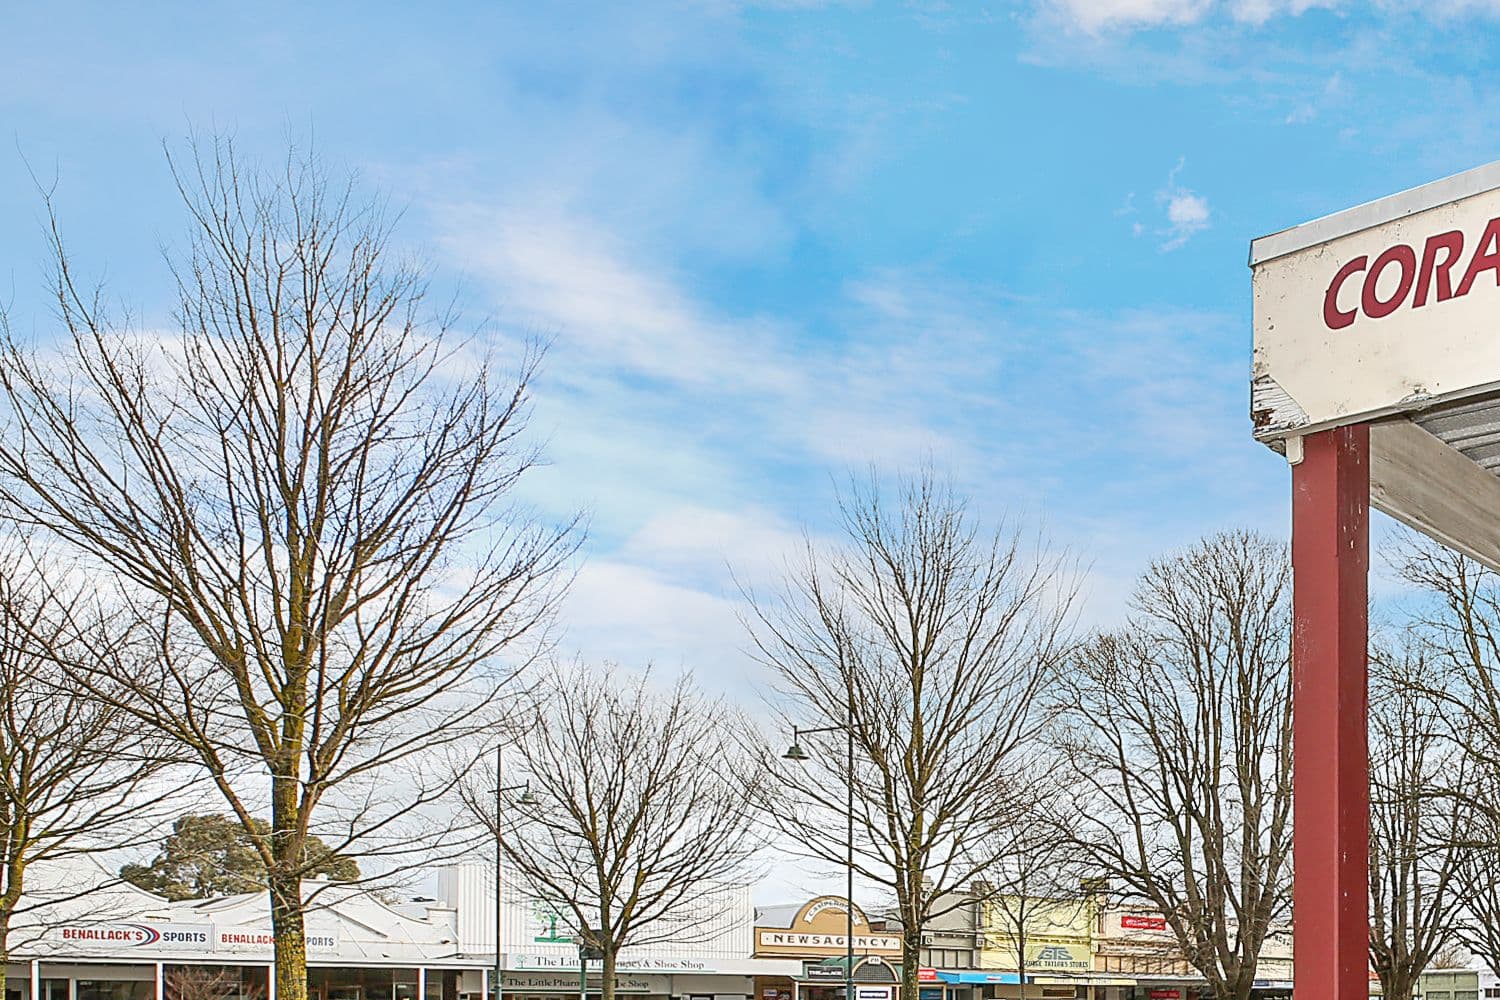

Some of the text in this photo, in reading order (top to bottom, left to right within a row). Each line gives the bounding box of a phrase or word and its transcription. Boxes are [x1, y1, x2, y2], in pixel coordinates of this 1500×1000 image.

[63, 928, 206, 943] BENALLACK'S SPORTS
[306, 936, 335, 947] PORTS
[535, 956, 557, 967] The
[654, 960, 678, 969] Shoe
[680, 960, 705, 971] Shop
[507, 978, 526, 987] The
[528, 978, 553, 987] Little
